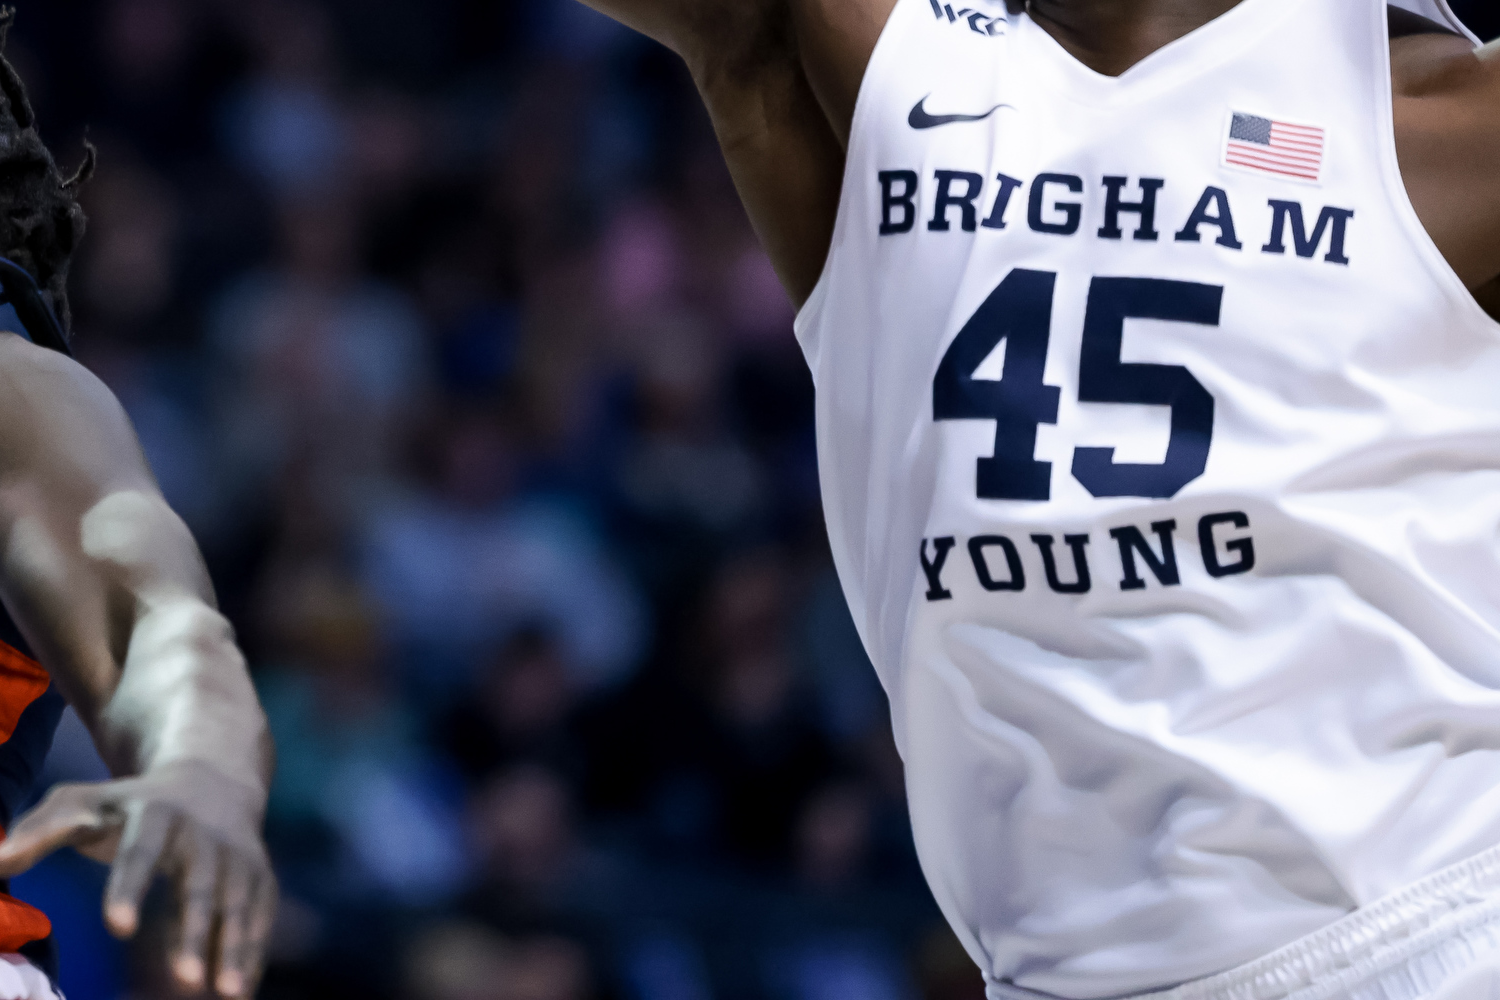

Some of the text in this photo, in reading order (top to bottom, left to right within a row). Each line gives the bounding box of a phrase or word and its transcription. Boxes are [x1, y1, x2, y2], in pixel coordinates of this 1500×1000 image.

[877, 168, 1356, 267] BRIGHAM
[932, 267, 1225, 502] 45
[920, 510, 1256, 602] YOUNG
